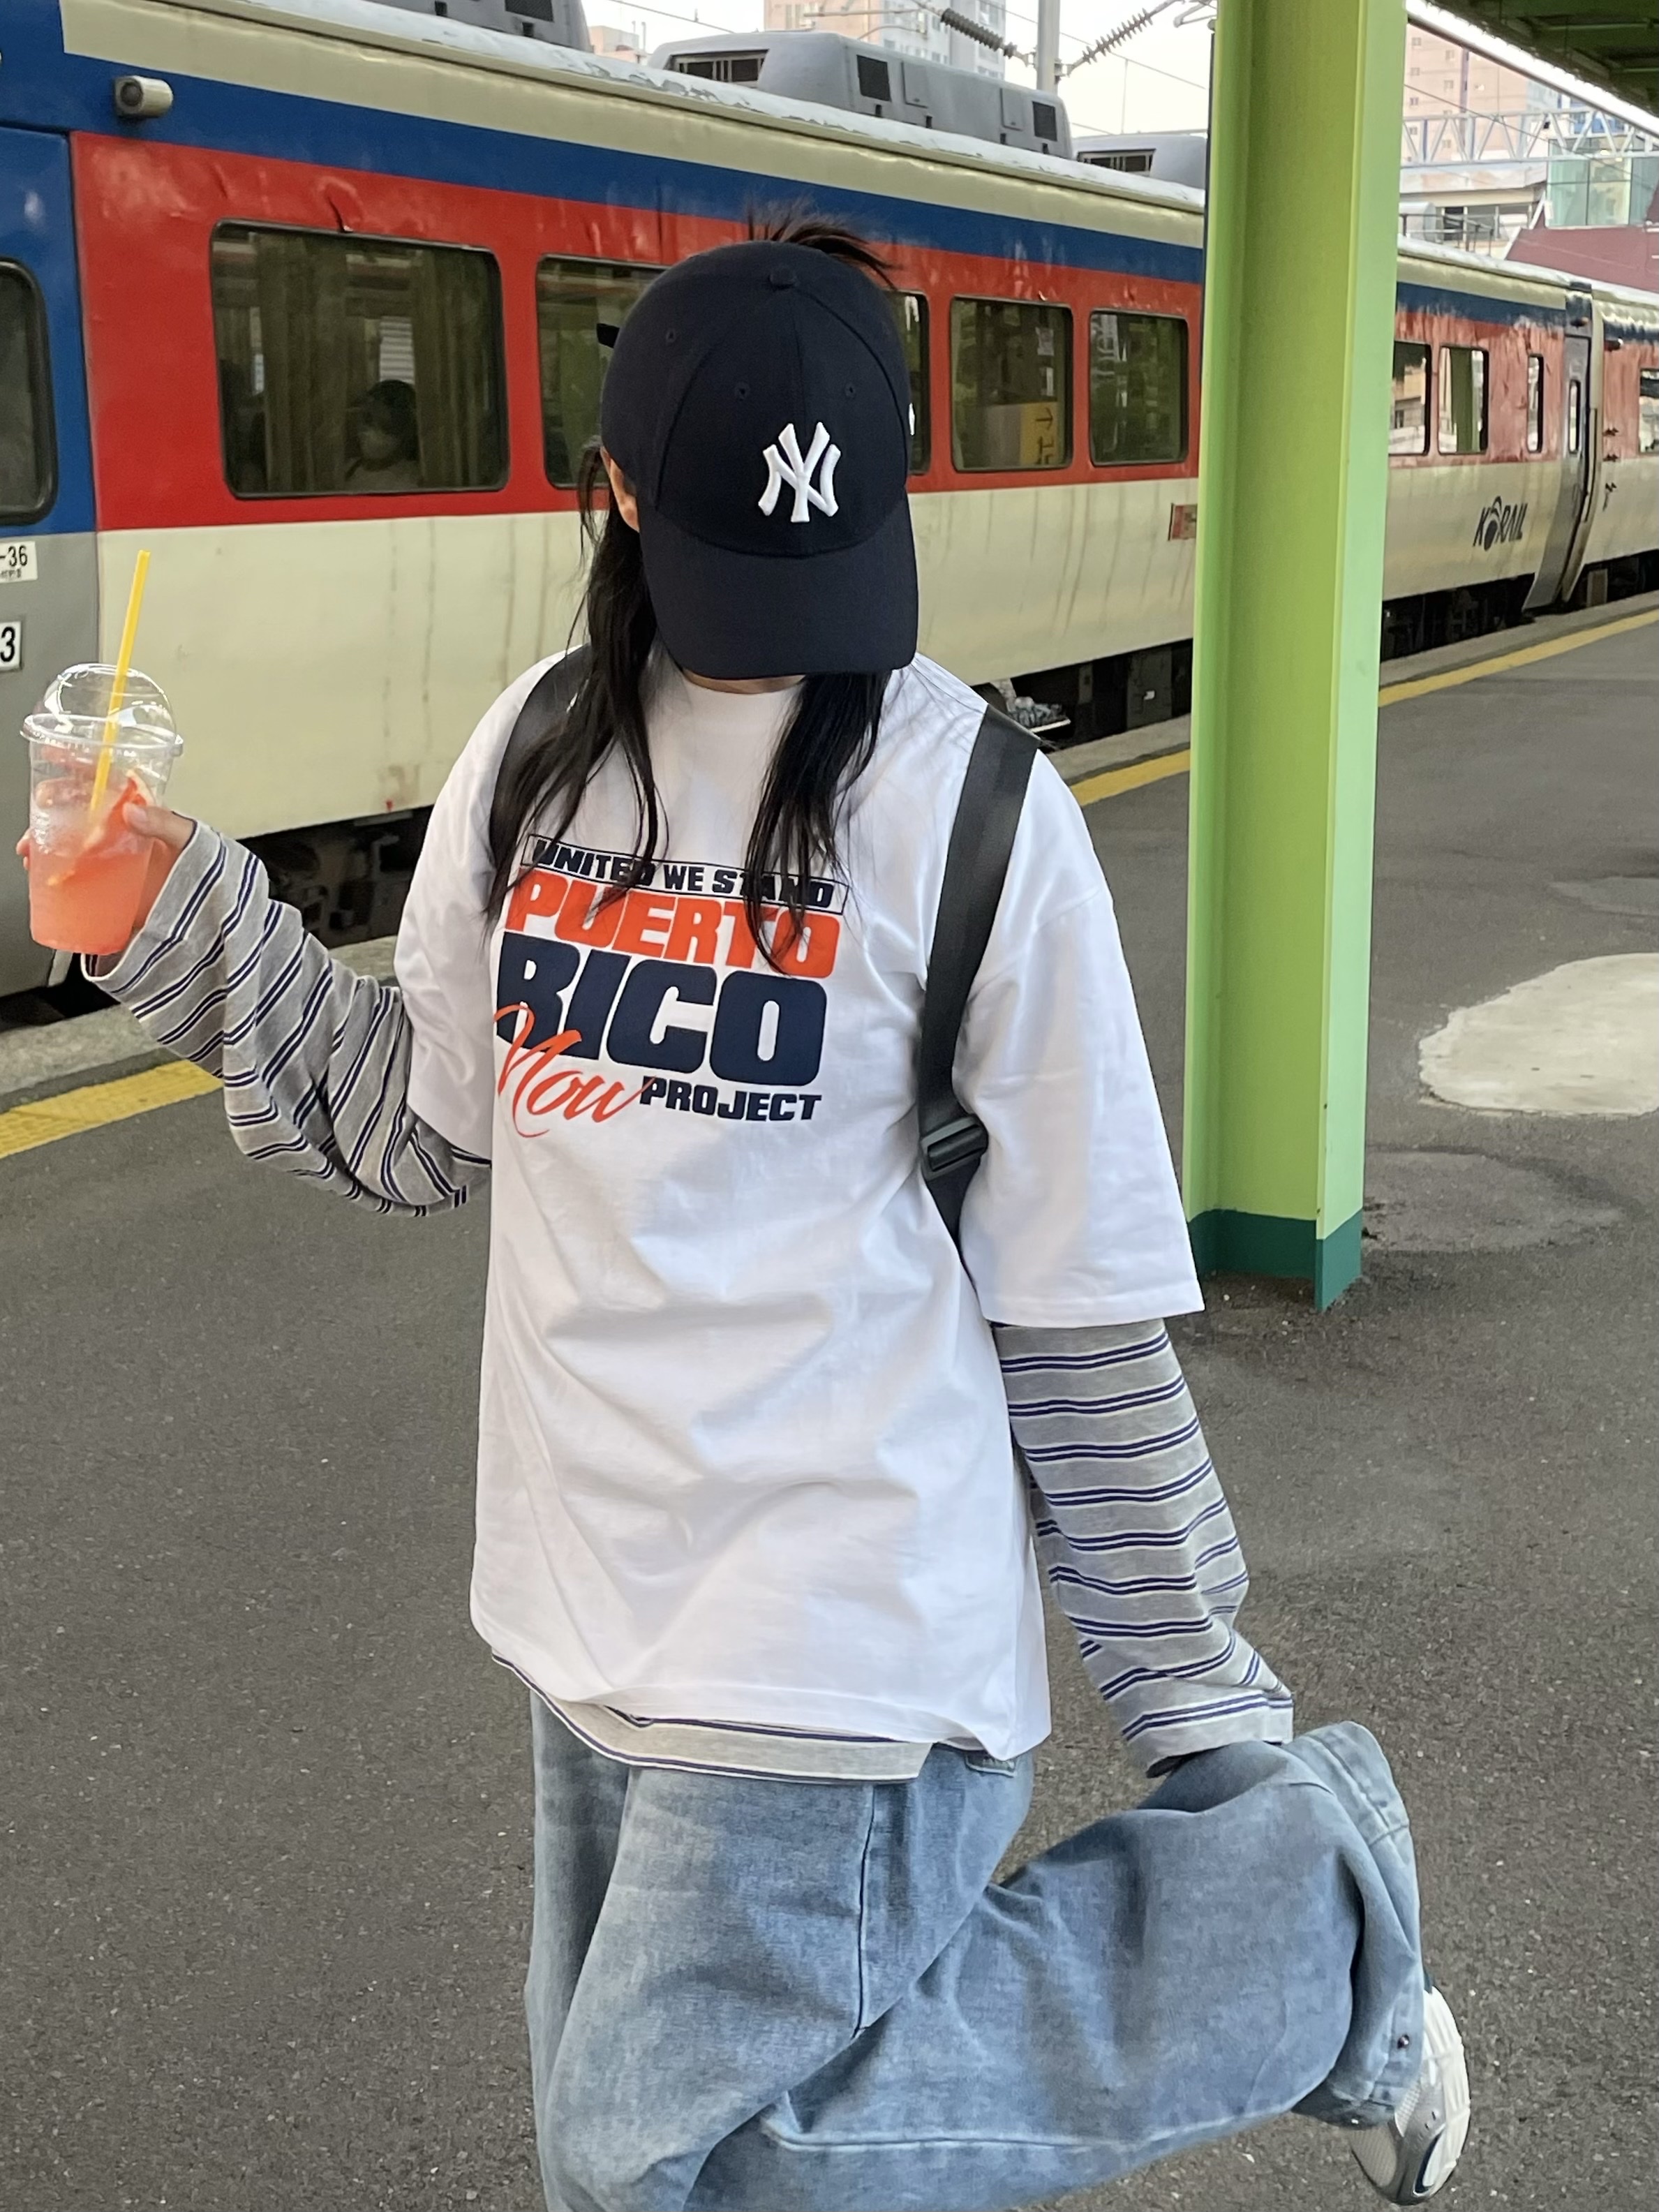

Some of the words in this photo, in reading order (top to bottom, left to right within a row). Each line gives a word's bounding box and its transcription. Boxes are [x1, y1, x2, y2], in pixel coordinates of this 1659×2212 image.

[758, 422, 841, 522] NY
[533, 839, 656, 886] UNITED
[663, 863, 705, 892] WE
[505, 866, 840, 979] PUERTO
[496, 931, 828, 1086] RICO
[639, 1076, 822, 1121] PROJECT
